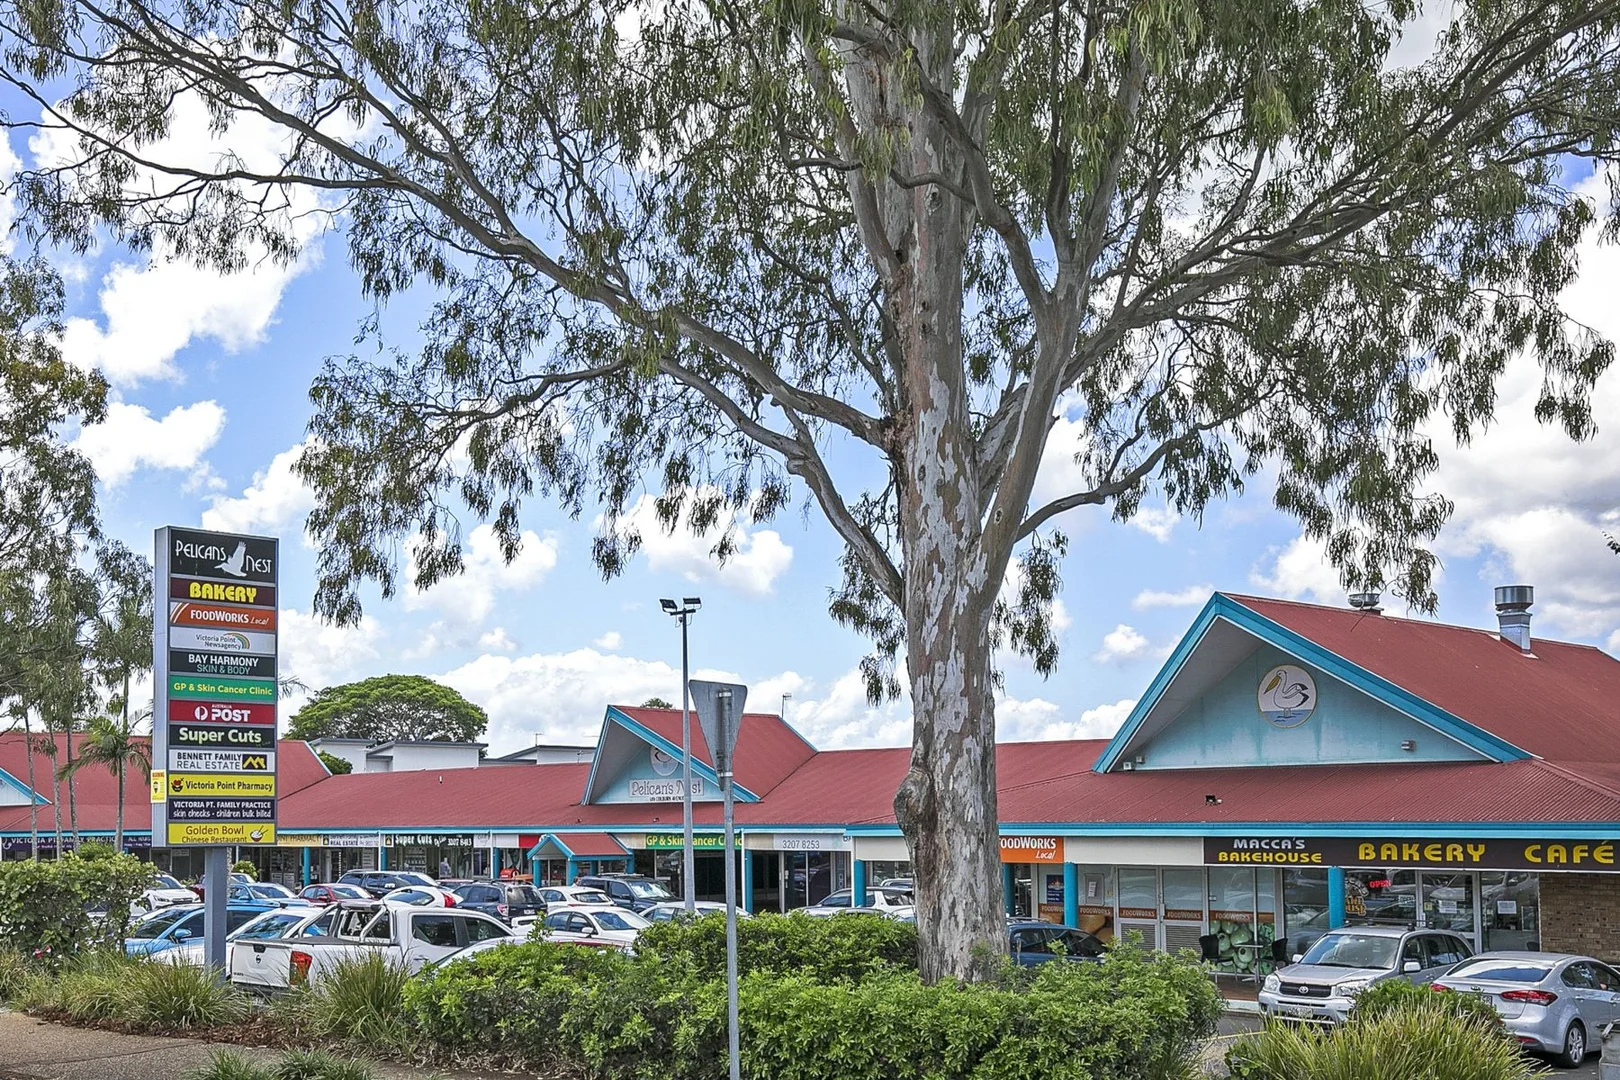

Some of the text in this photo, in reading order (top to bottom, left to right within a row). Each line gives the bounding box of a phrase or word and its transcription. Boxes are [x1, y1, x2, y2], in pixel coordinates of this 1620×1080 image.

[175, 539, 272, 573] PELICANS NEST
[189, 582, 257, 603] BAKERY
[190, 610, 270, 625] FOODWORKS Local
[196, 634, 219, 642] Victoria
[204, 641, 241, 650] Newsagency
[188, 654, 259, 667] BAY HARMONY
[197, 664, 250, 674] SKIN & BODY
[174, 683, 272, 695] GP & Skin Cancer Clinic
[211, 709, 251, 722] POST
[179, 727, 262, 744] Super Cuts
[177, 752, 242, 761] BENNETT FAMILY
[177, 761, 240, 770] REAL ESTATE
[185, 781, 273, 792] Victoria Point Pharmacy
[631, 779, 702, 796] Pelican's Nst
[173, 809, 271, 817] skin checks children bulk billed
[185, 825, 244, 835] Golden Bowl
[395, 834, 414, 847] Super
[417, 834, 432, 845] Cuts
[646, 835, 658, 845] GP
[659, 836, 666, 845] &
[667, 835, 685, 846] Skin
[692, 836, 716, 846] ancer
[782, 840, 820, 849] 3207 8253
[999, 837, 1056, 849] OODWORKS
[1233, 838, 1306, 849] MACCA'S
[1035, 850, 1056, 859] Local
[1218, 852, 1322, 863] BAKEHOUSE
[1358, 840, 1614, 864] BAKERY CAFÉ
[1369, 880, 1391, 888] OPEN
[1080, 906, 1111, 915] FOODWORKS
[1215, 913, 1251, 921] FOODWORKS
